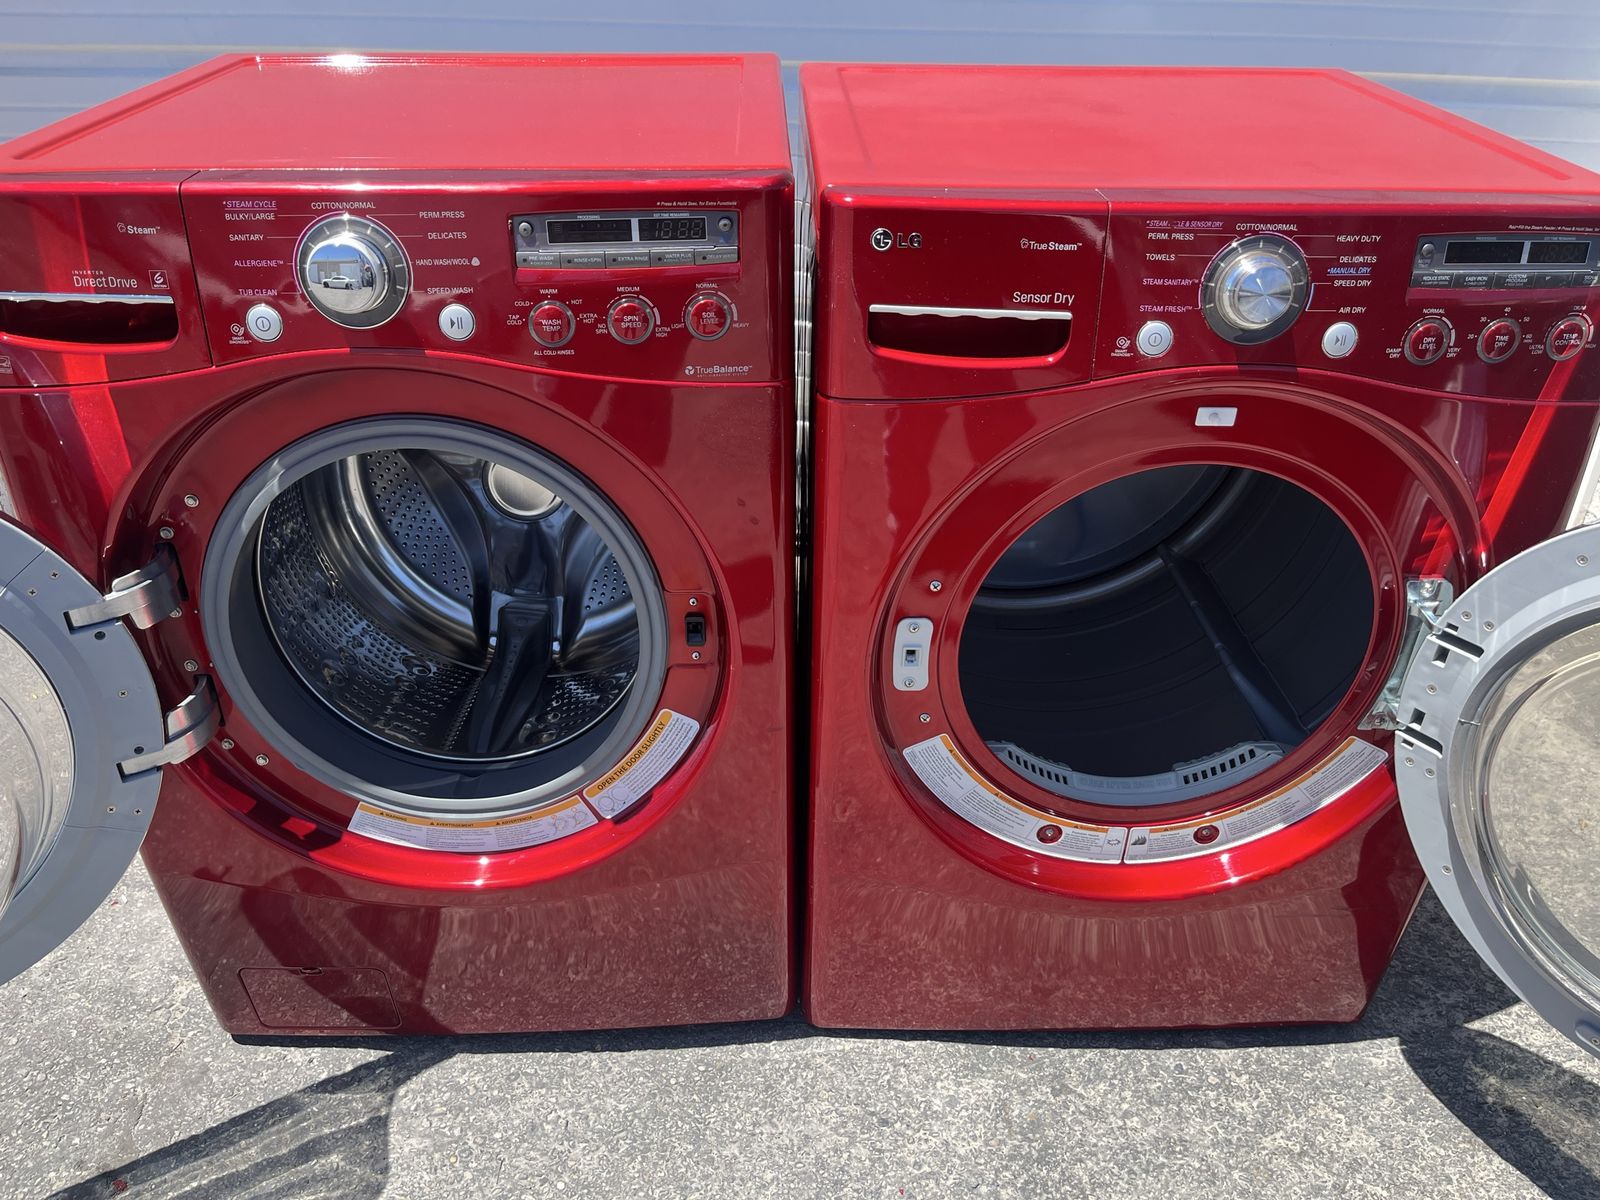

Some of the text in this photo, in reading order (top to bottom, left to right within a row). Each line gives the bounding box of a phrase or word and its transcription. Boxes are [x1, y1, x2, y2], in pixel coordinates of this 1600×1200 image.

[254, 200, 277, 208] CYCLE
[311, 201, 376, 210] COTTON/NORMAL
[224, 212, 275, 221] BULKY/LARGE
[442, 211, 465, 219] PRESS
[1235, 223, 1298, 232] COTTON/NORMAL
[229, 233, 264, 242] SANITARY
[427, 231, 467, 240] DELICATES
[1148, 232, 1194, 241] PERM. PRESS
[897, 233, 923, 249] LG
[1146, 253, 1176, 261] TOWELS
[433, 258, 470, 266] WASH/WOOL
[1143, 278, 1163, 286] STEAM
[1333, 279, 1372, 287] SPEED DRY
[238, 288, 277, 296] TUB CLEAN
[427, 286, 474, 295] SPEED WASH
[1012, 291, 1075, 306] Sensor Dry
[1139, 304, 1163, 313] STEAM
[1338, 306, 1352, 314] AIR
[1419, 342, 1437, 350] LEVEL
[597, 720, 666, 791] OPEN THE DOOR SLIGHTLY
